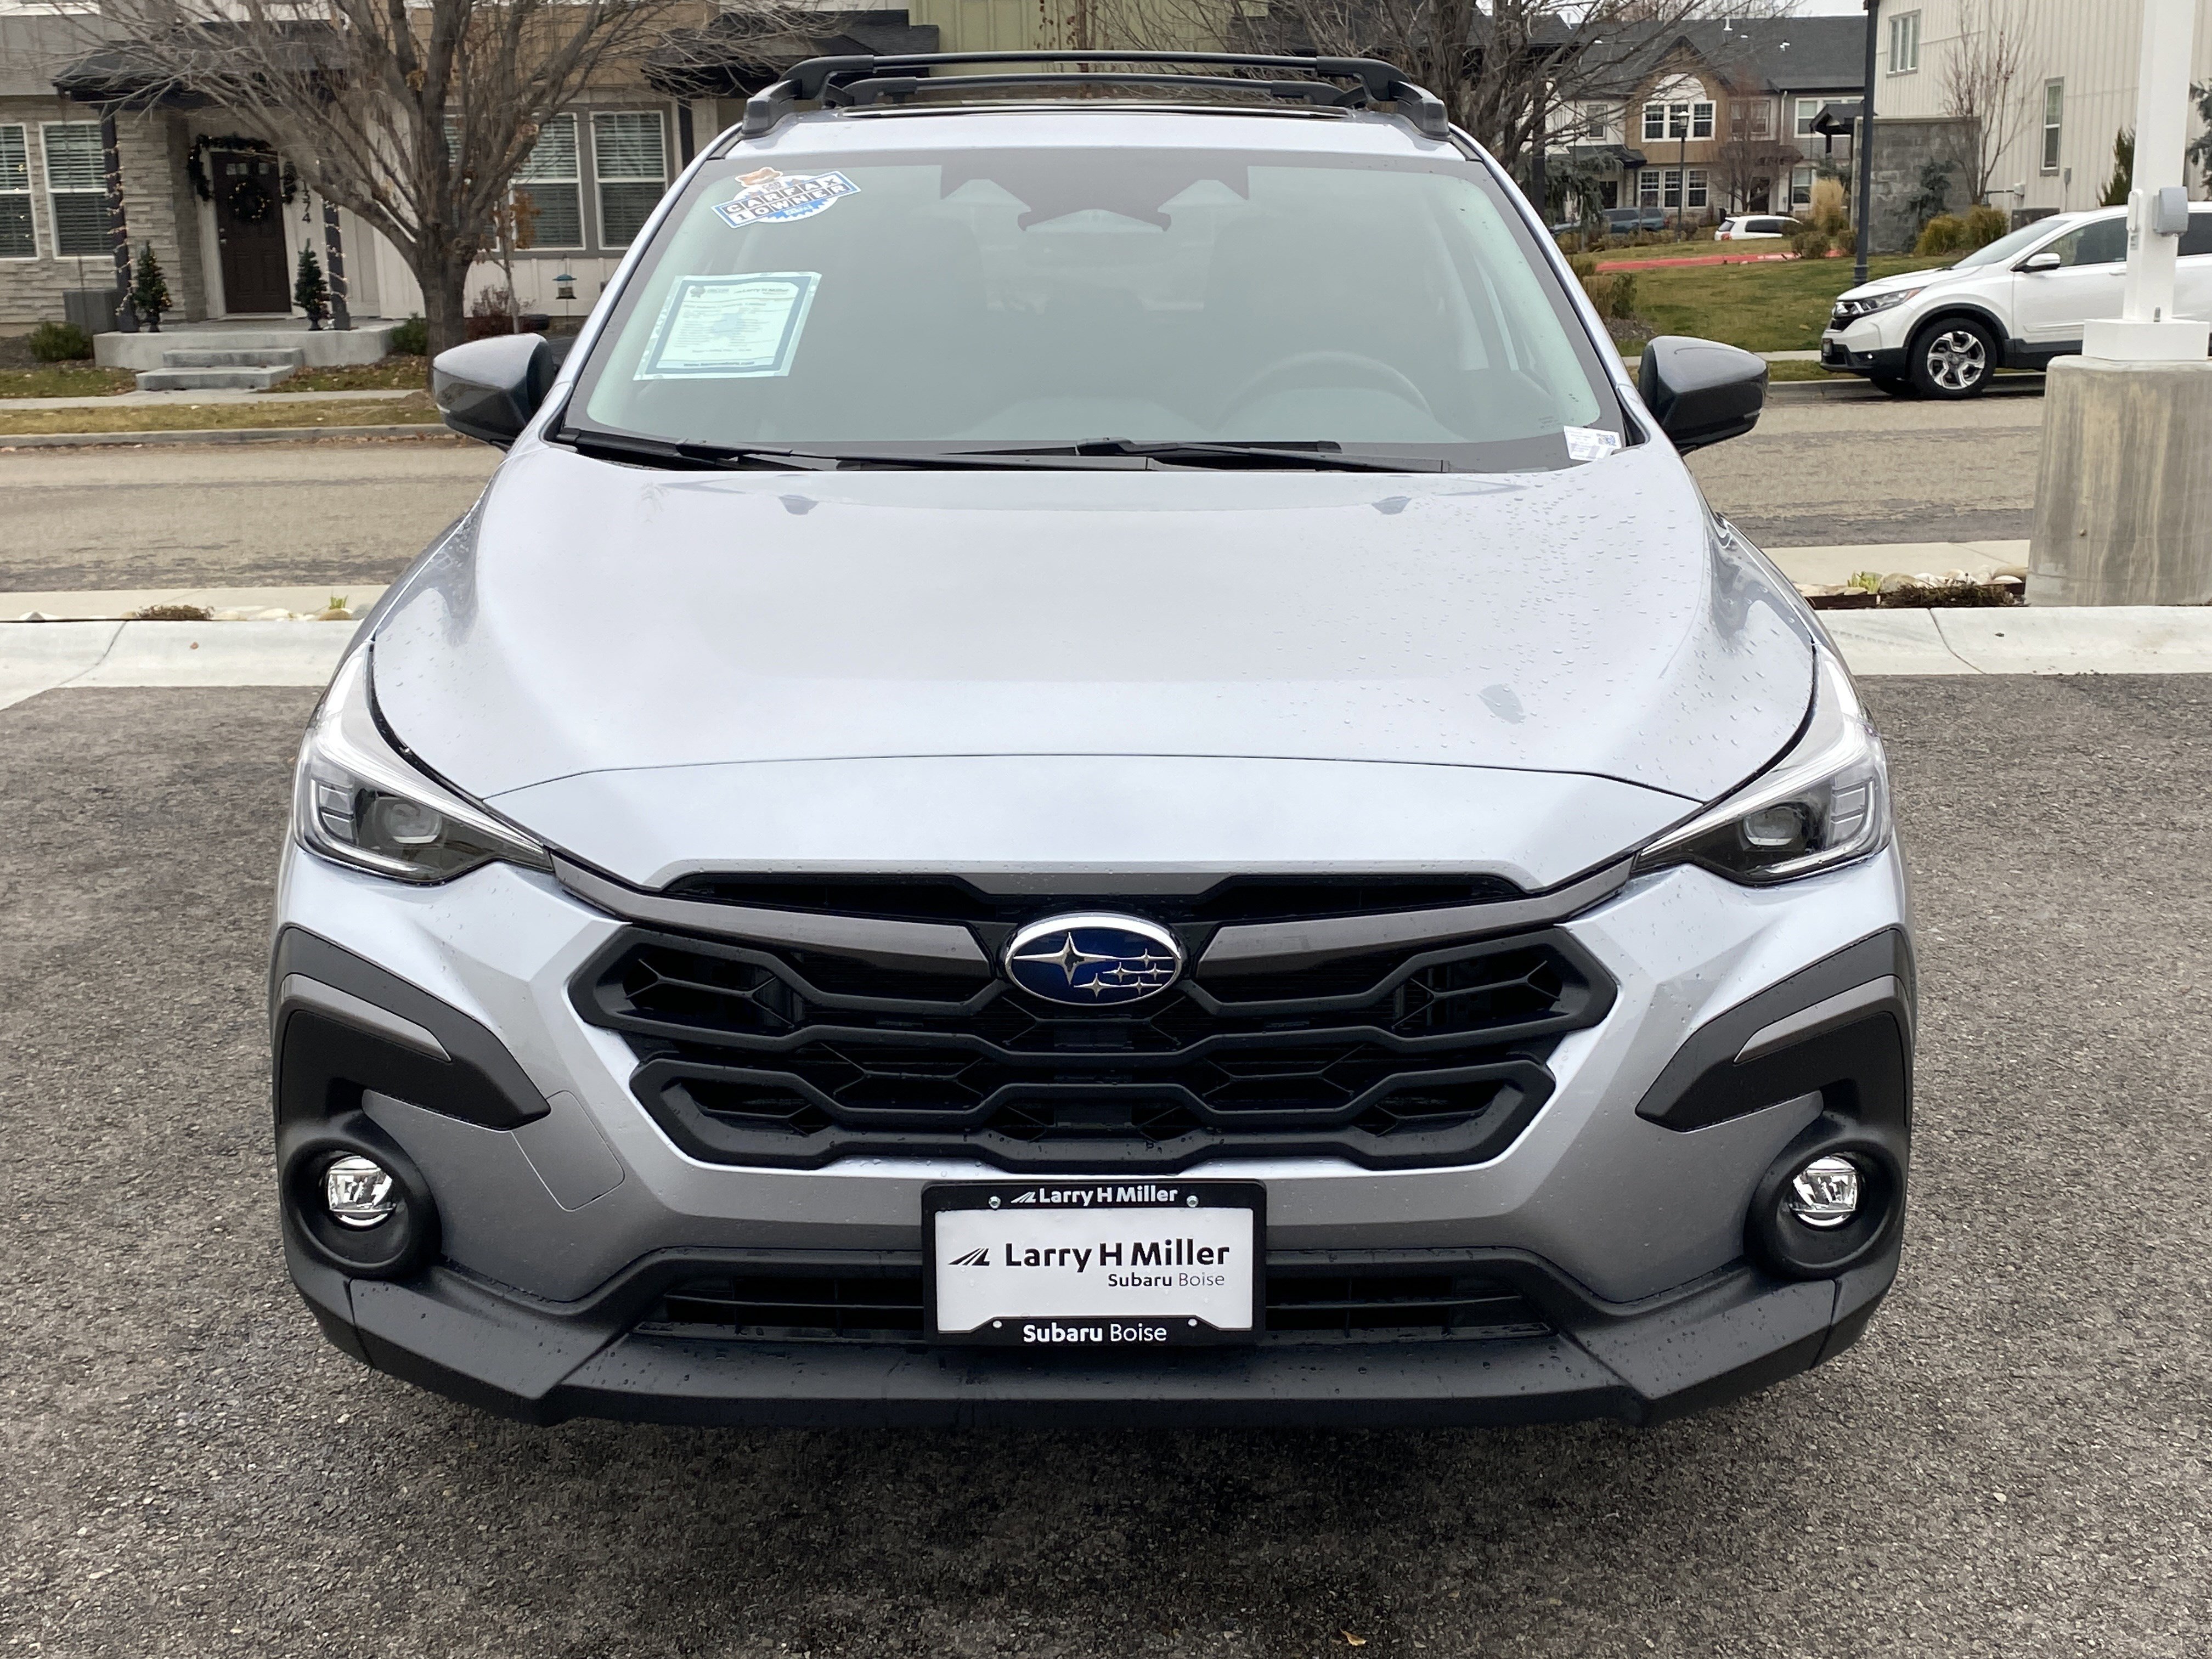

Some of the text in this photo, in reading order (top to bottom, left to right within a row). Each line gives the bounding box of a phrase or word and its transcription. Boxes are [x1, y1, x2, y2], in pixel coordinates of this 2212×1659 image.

[727, 178, 837, 212] CARFAX
[754, 185, 847, 215] OWNER
[1039, 1186, 1178, 1206] Larry H Miller
[1005, 1239, 1230, 1273] Larry H Miller
[1108, 1272, 1225, 1287] Subaru Boise
[1023, 1322, 1167, 1342] Subaru Boise
